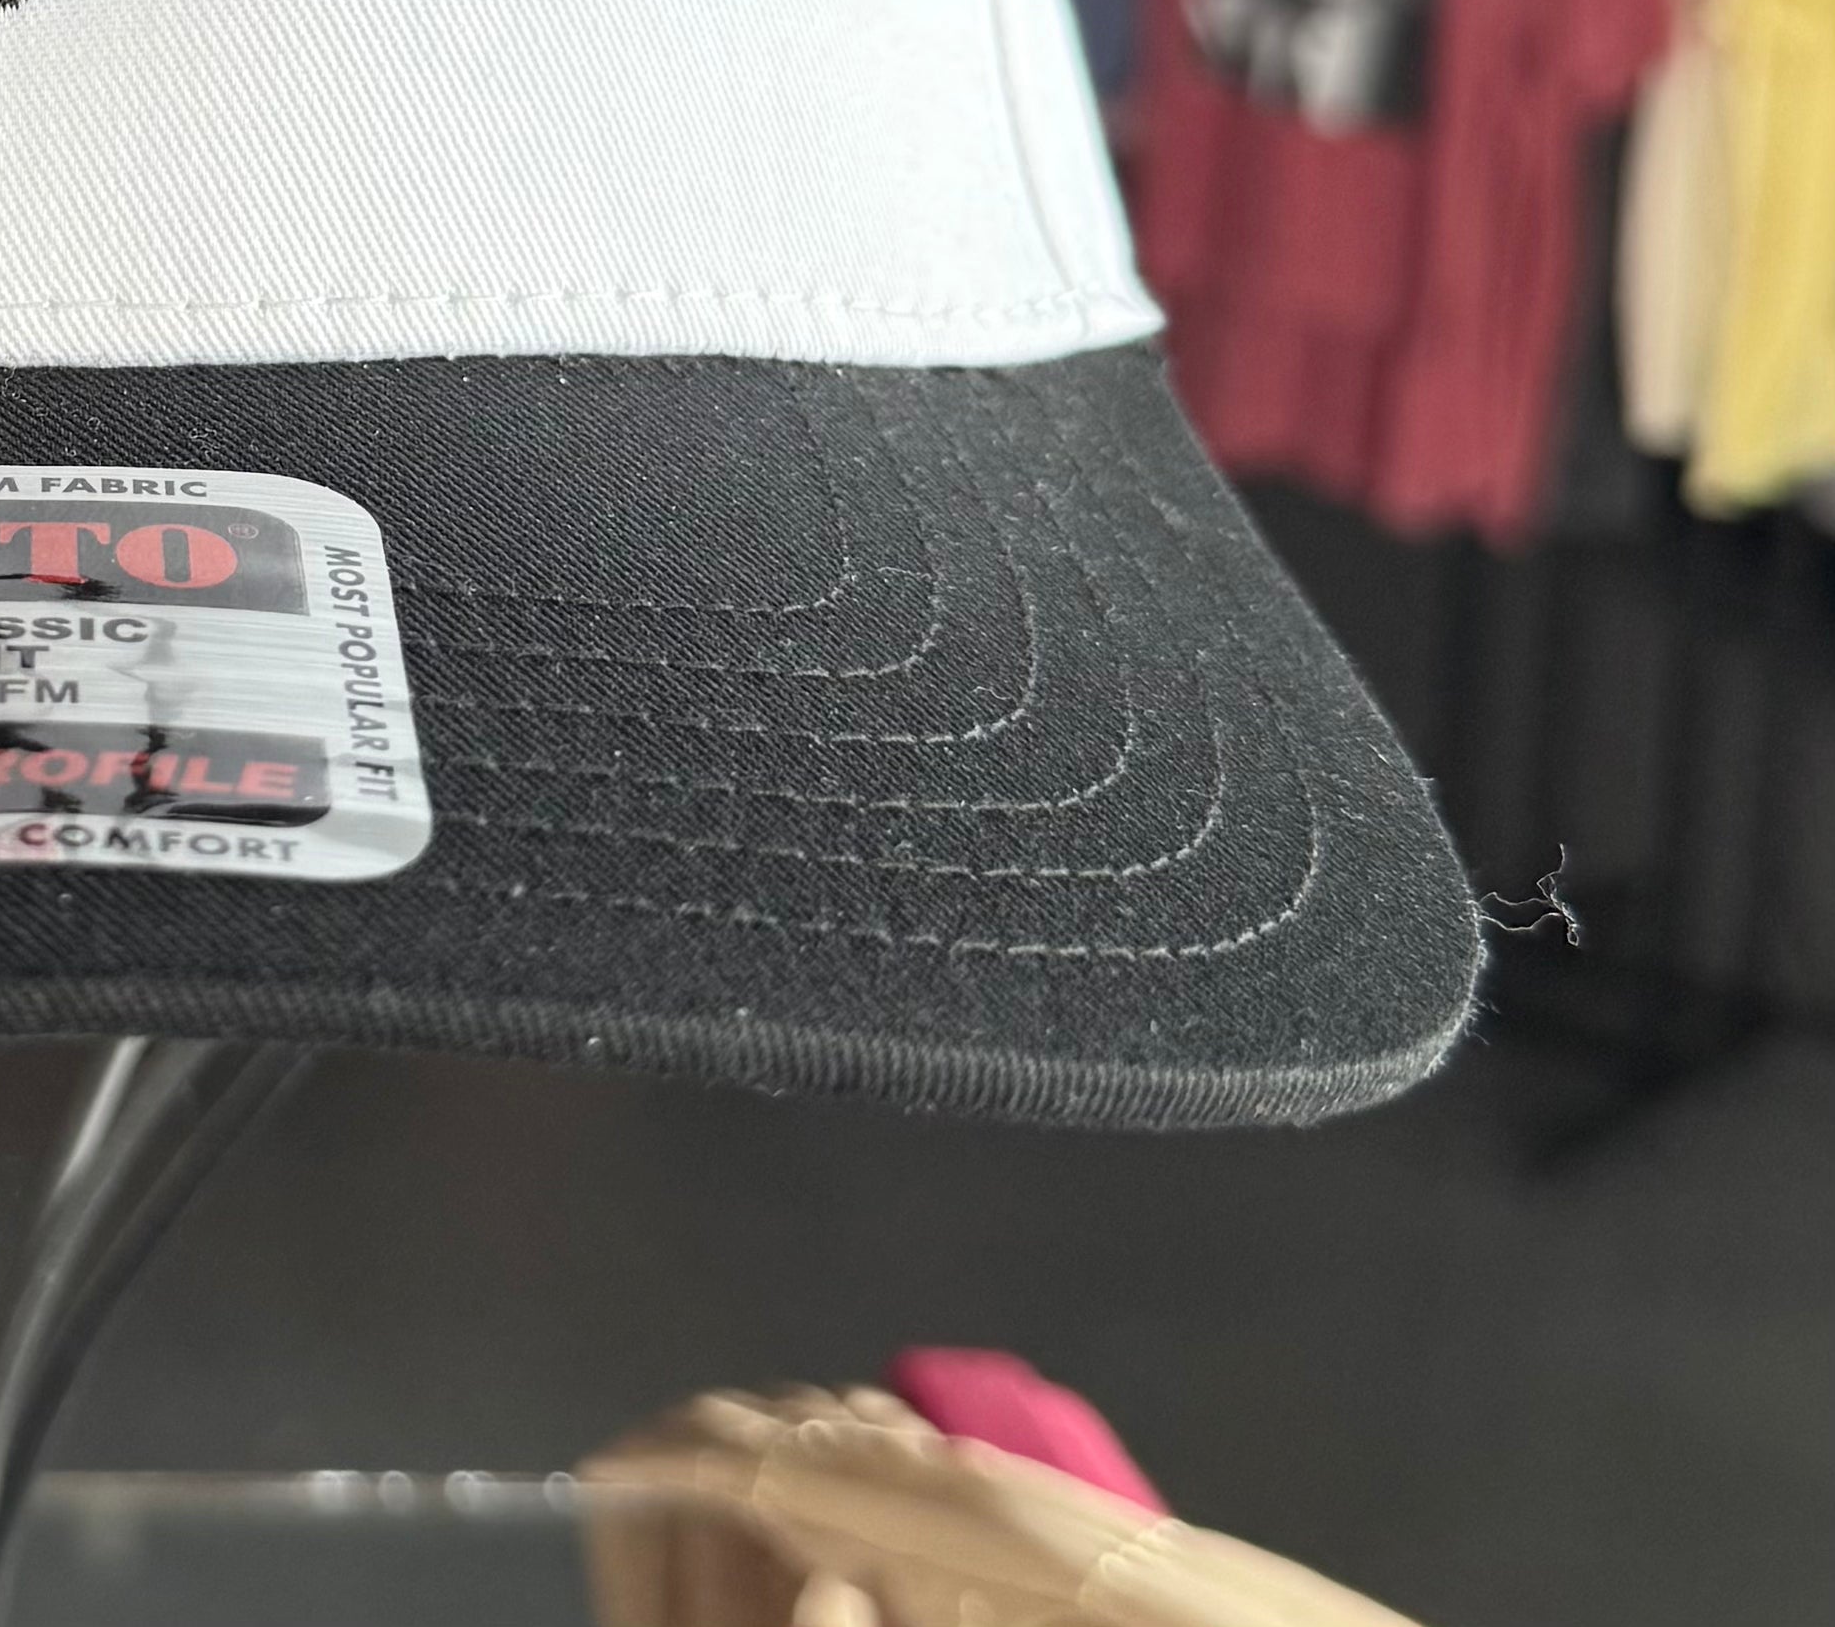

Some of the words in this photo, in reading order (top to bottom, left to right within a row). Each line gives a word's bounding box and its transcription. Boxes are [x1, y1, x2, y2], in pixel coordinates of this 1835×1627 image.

[40, 477, 208, 498] FABRIC
[323, 544, 370, 618] MOST
[335, 621, 391, 752] POPULAR
[354, 760, 399, 802] FIT
[18, 823, 303, 863] COMFORT
